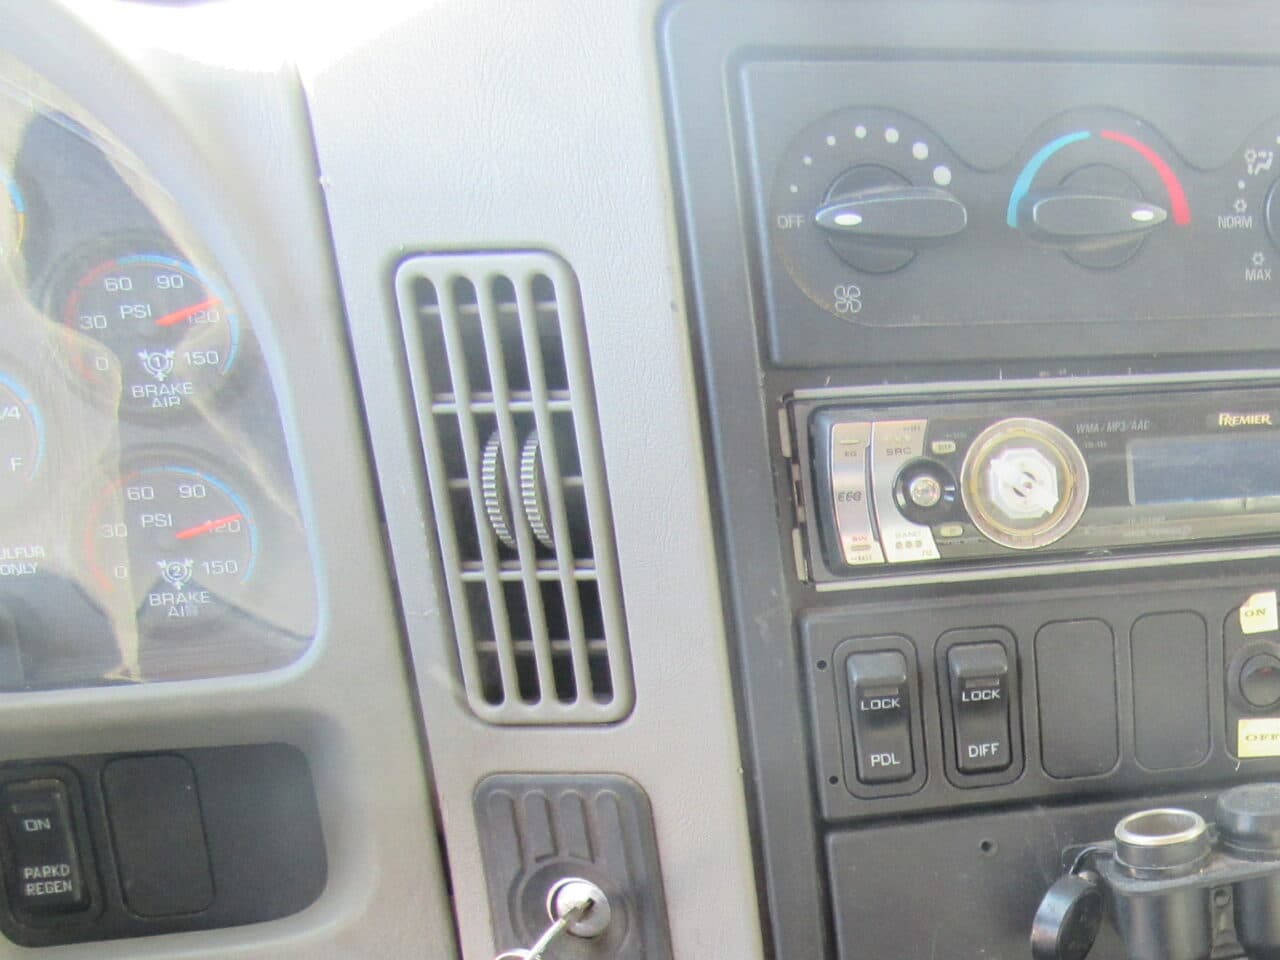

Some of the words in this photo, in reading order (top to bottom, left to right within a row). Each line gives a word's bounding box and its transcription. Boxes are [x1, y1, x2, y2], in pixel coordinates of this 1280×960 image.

[776, 215, 806, 228] OFF
[1217, 215, 1253, 229] NORM
[1245, 267, 1273, 281] MAX
[105, 276, 133, 292] 60
[156, 275, 184, 290] 90
[120, 304, 152, 321] PSI
[80, 315, 107, 330] 30
[96, 356, 109, 371] 0
[184, 350, 219, 366] 150
[132, 381, 195, 399] BRAKE
[151, 395, 181, 409] AIR
[10, 457, 24, 472] F
[128, 486, 154, 501] 60
[179, 485, 206, 499] 90
[141, 513, 172, 528] PSI
[102, 523, 128, 539] 30
[0, 546, 45, 561] ULFUR
[0, 561, 38, 577] ONLY
[115, 564, 127, 580] 0
[203, 560, 238, 575] 150
[149, 591, 212, 607] BRAKE
[1243, 607, 1268, 620] ON
[960, 688, 1001, 703] LOCK
[860, 696, 901, 712] LOCK
[967, 742, 1000, 758] DIFF
[870, 753, 901, 768] PDL
[23, 817, 51, 832] ON
[23, 863, 71, 880] PARKD
[25, 880, 73, 896] REGEN
